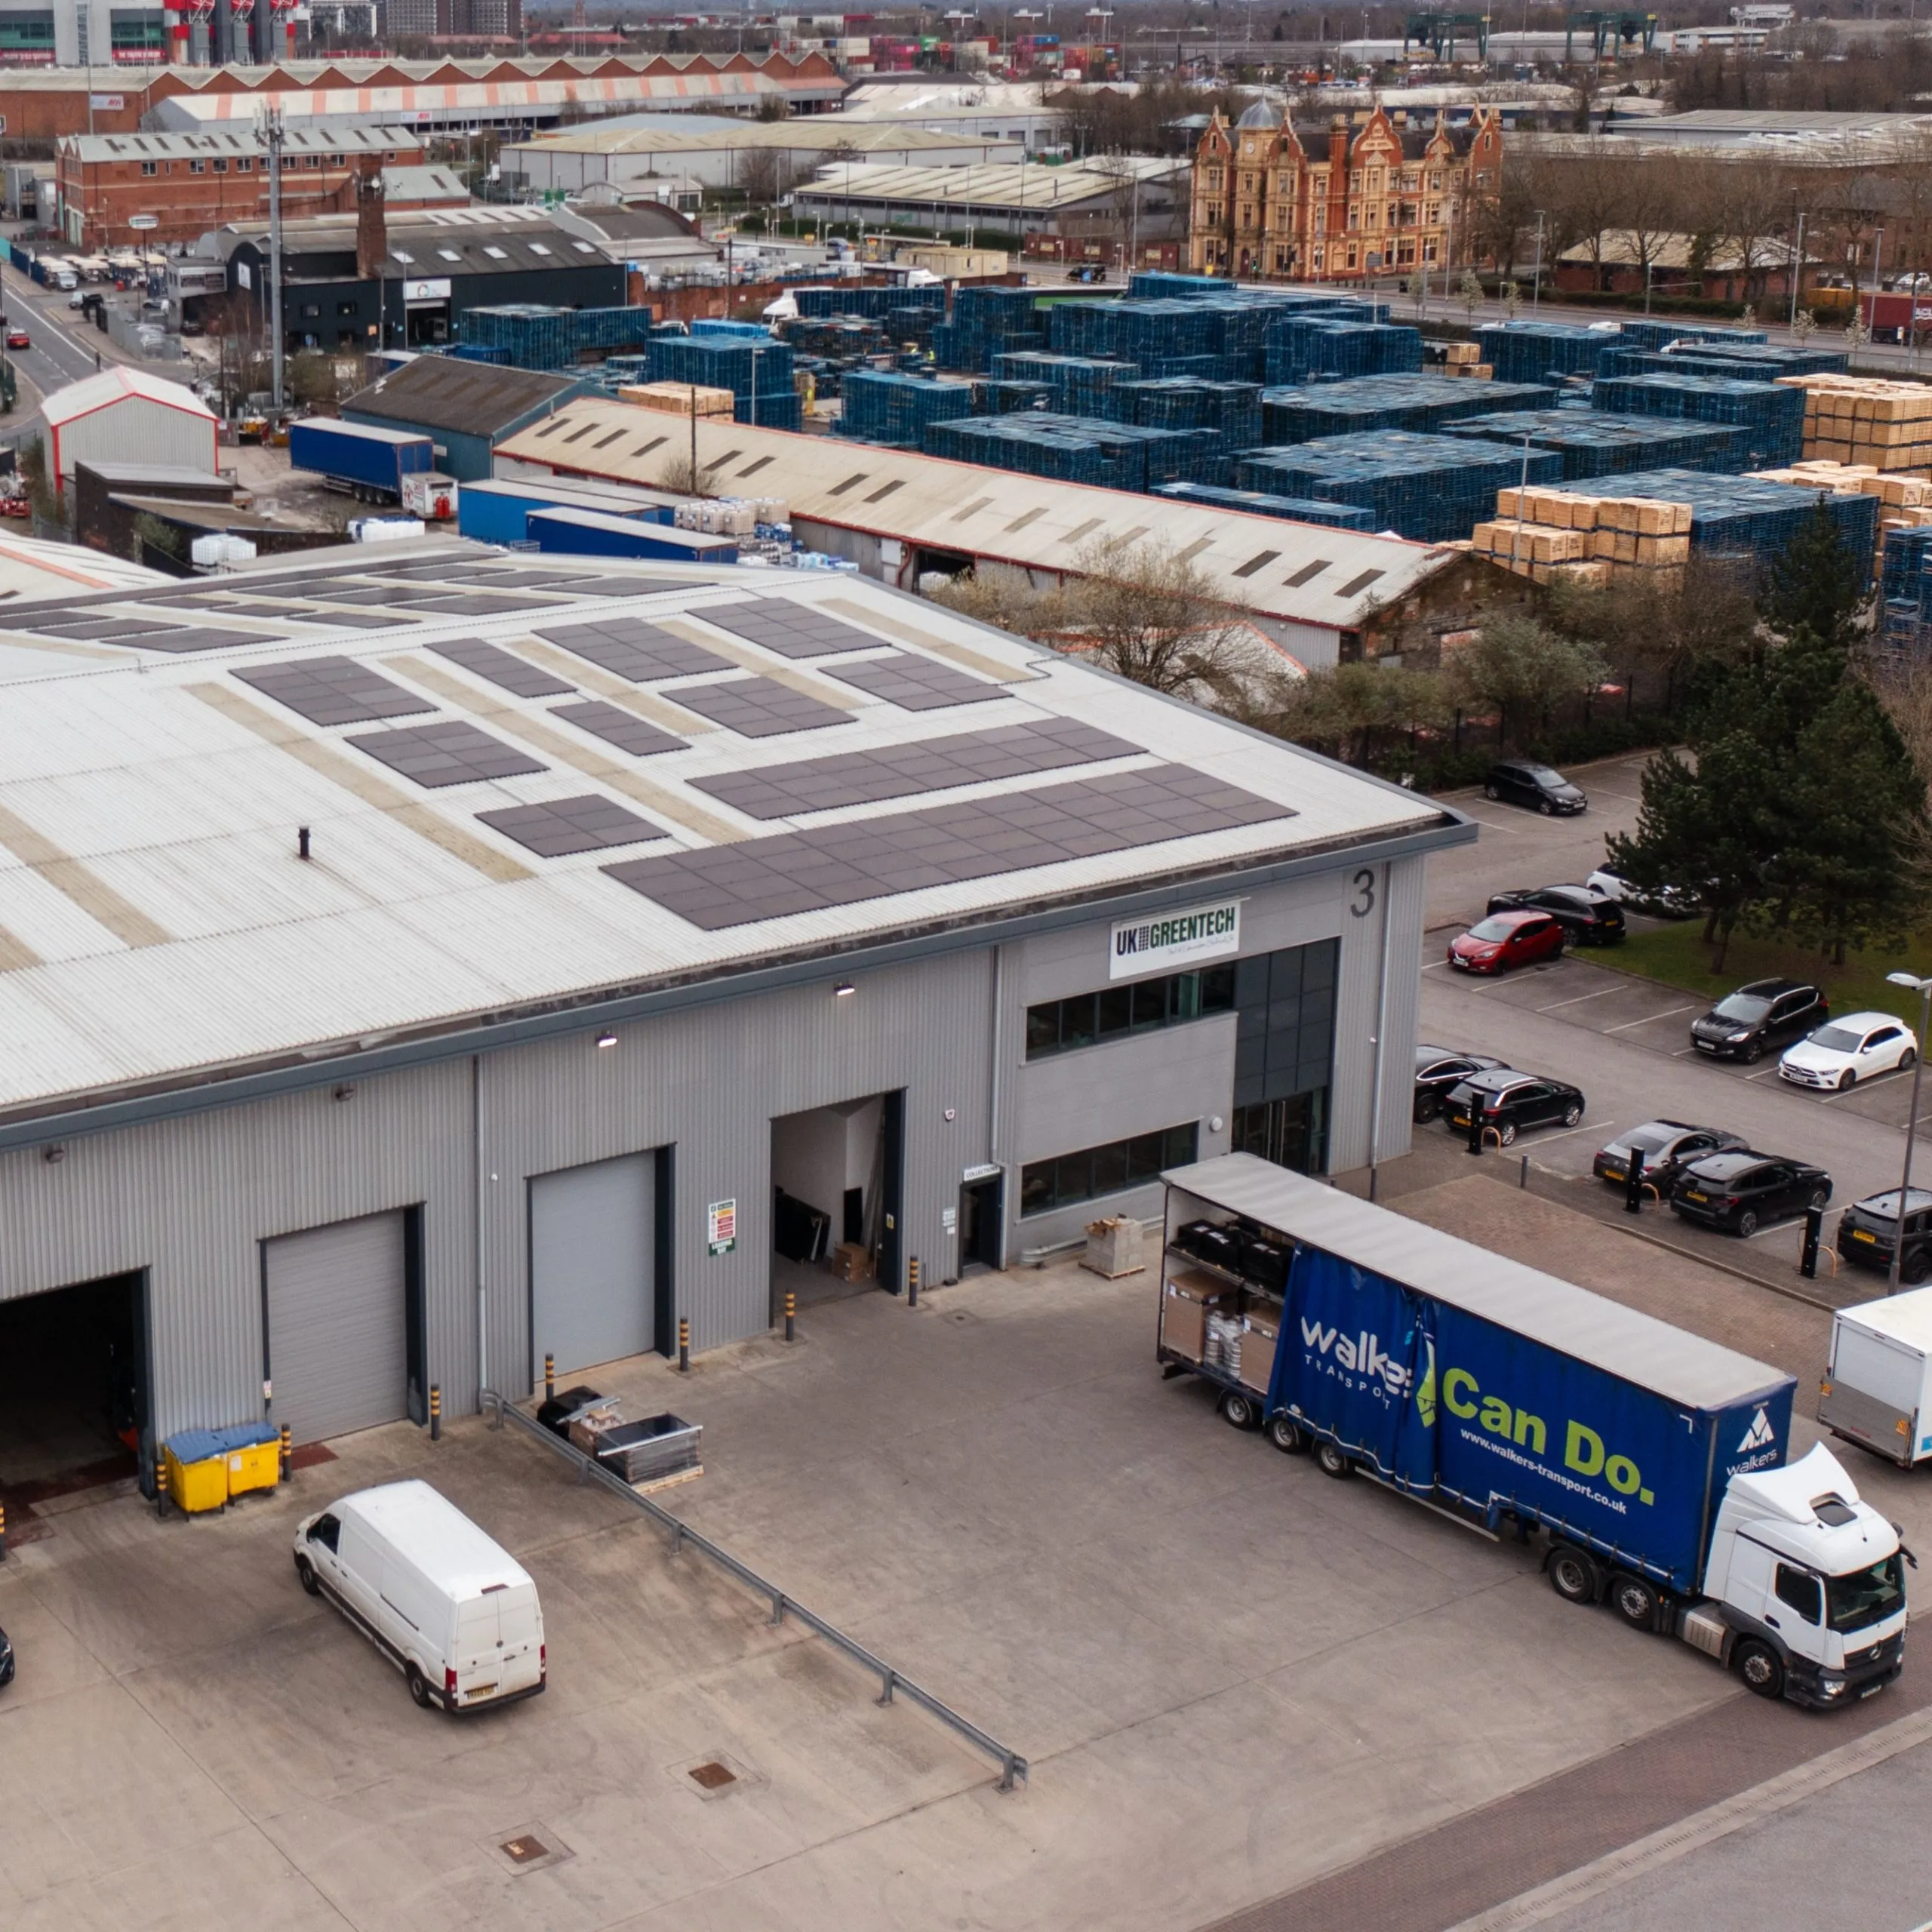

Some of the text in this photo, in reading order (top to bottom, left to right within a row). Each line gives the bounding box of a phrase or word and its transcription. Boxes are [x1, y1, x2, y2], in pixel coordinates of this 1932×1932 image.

[1350, 869, 1375, 918] 3
[1116, 928, 1138, 955] UK
[1150, 907, 1235, 949] GREENTECH
[1304, 1355, 1391, 1410] TRANSPOT
[1443, 1367, 1654, 1506] Can Do.
[1726, 1449, 1778, 1476] walkers
[1460, 1429, 1627, 1514] www.walkers-transport.co.uk
